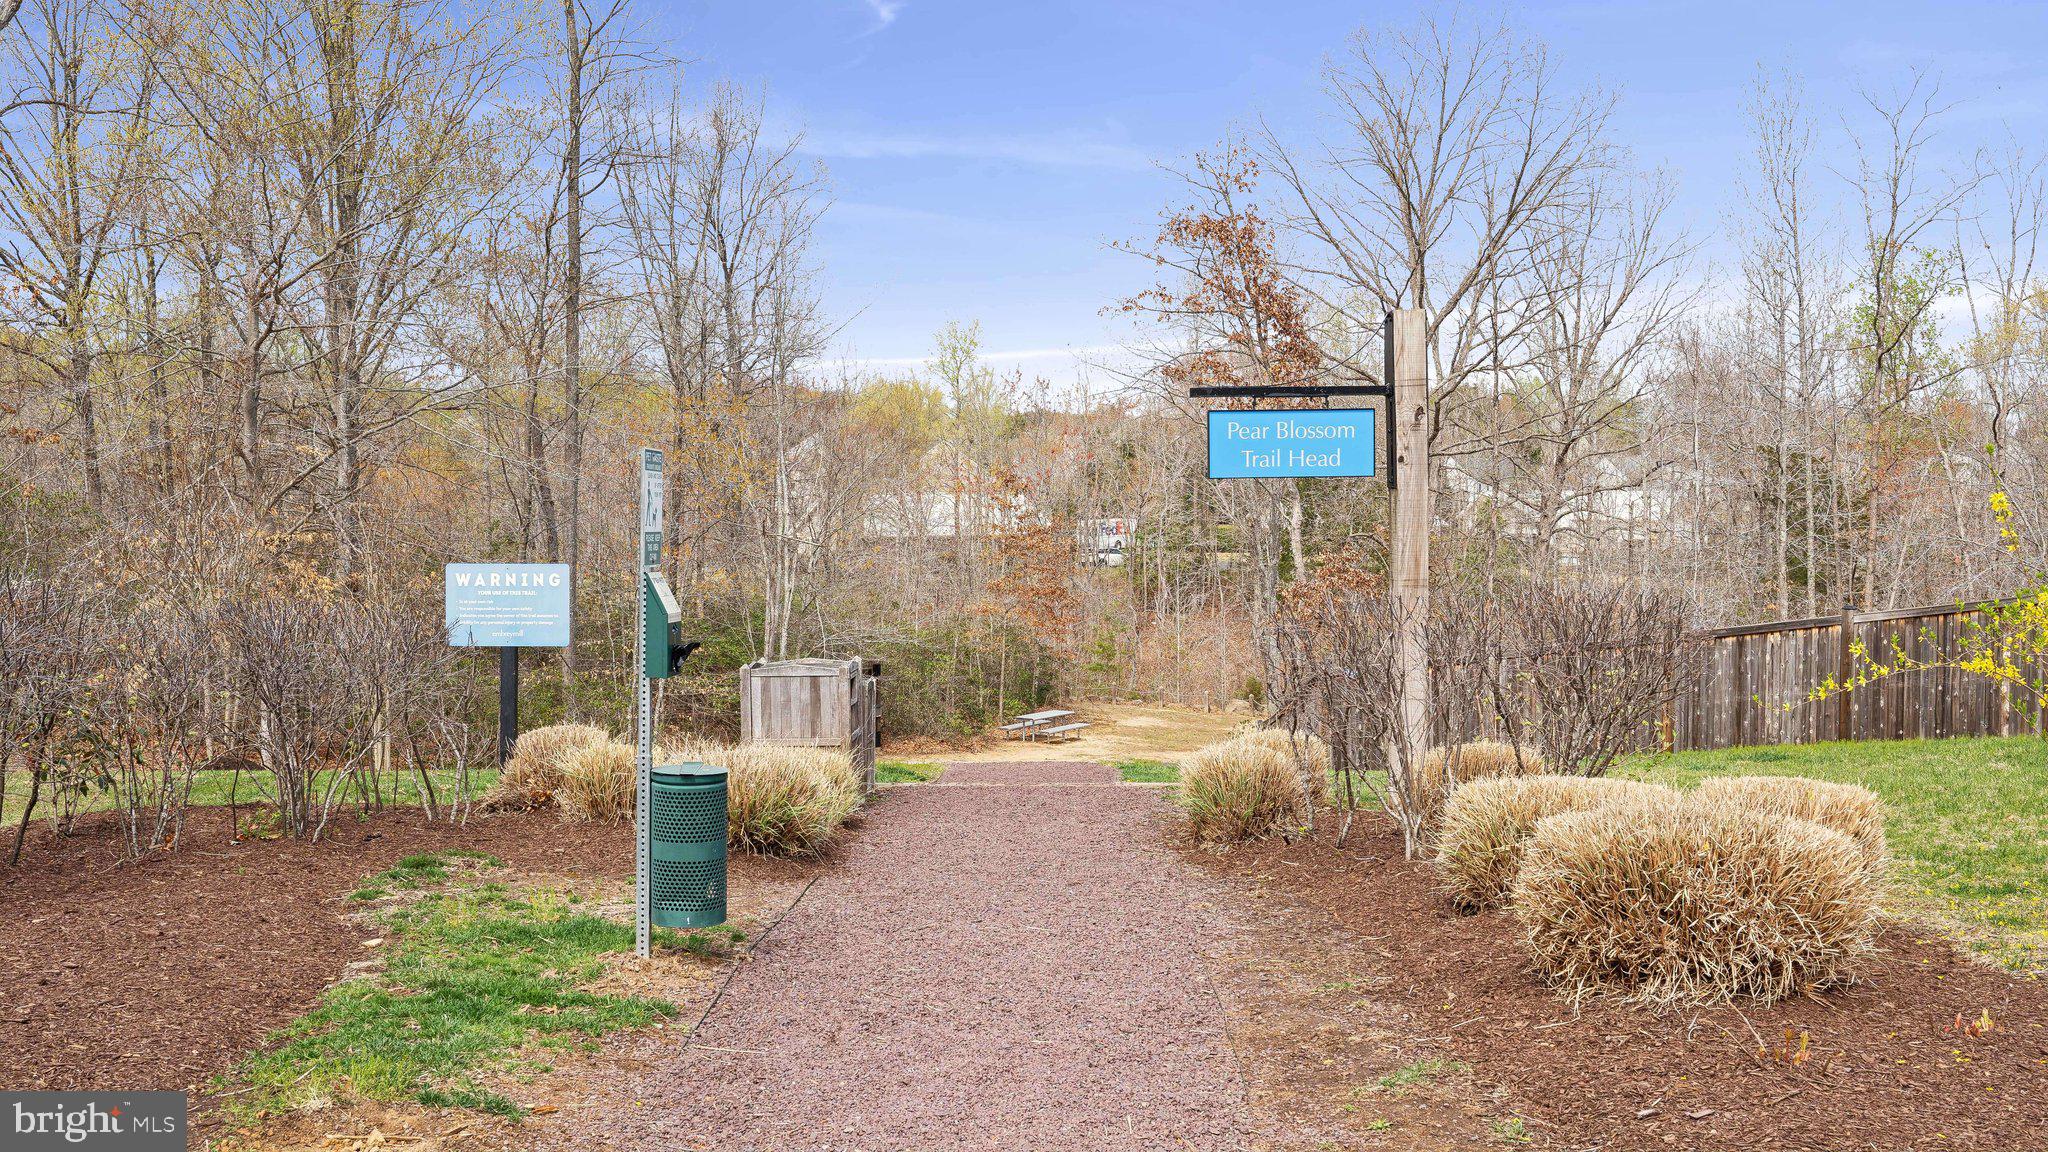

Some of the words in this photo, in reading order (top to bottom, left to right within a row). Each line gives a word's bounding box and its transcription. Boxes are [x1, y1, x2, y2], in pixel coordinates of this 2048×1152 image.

[1227, 421, 1270, 440] Pear
[1276, 420, 1356, 440] Blossom
[1241, 449, 1281, 468] Trail
[1289, 448, 1341, 467] Head
[455, 573, 561, 587] WARNING
